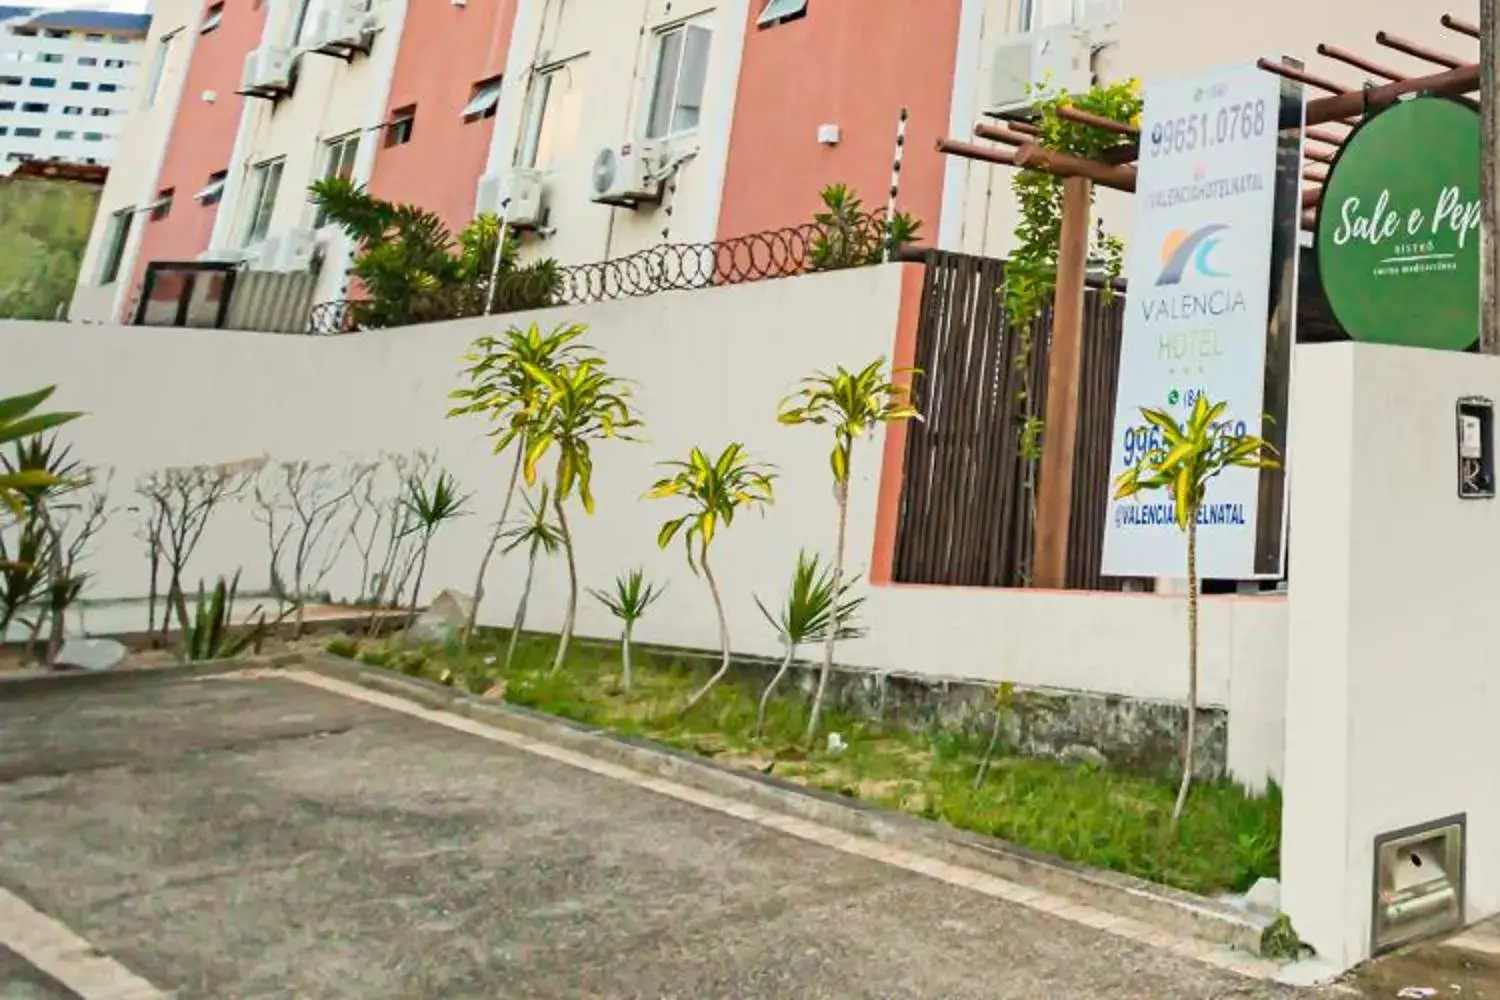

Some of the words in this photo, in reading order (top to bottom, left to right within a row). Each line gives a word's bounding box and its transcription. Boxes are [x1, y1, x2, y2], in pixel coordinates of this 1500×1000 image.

[1150, 99, 1265, 158] 99651.0768
[1333, 188, 1400, 245] Sale
[1407, 208, 1425, 236] e
[1431, 185, 1481, 249] Pep
[1141, 288, 1246, 322] VALENCIA
[1158, 328, 1225, 360] HOTEL
